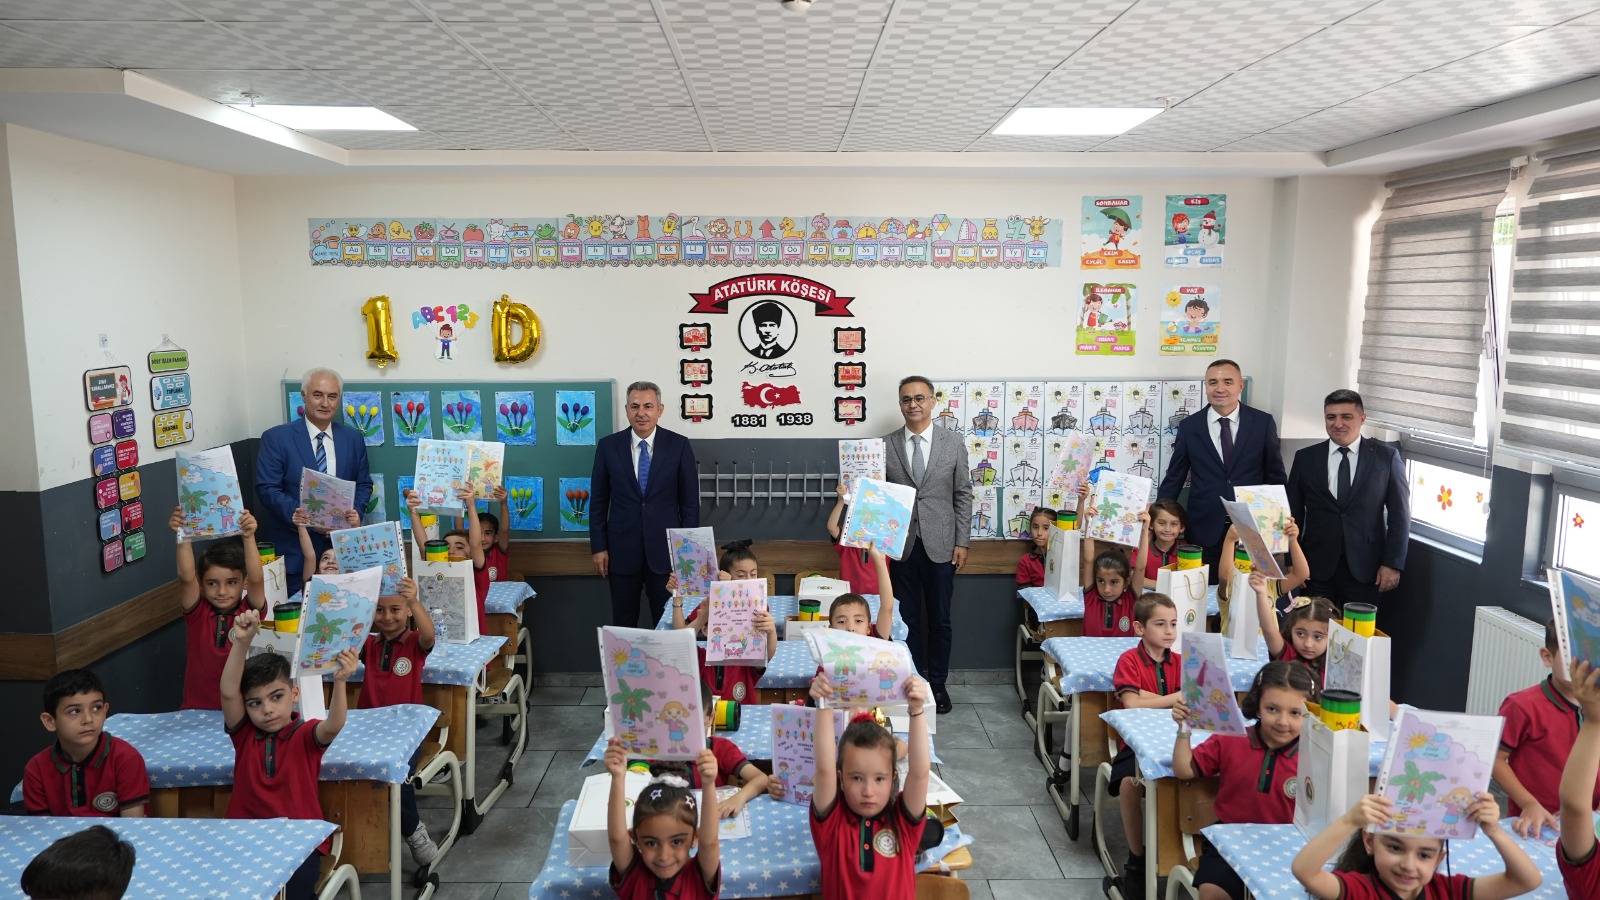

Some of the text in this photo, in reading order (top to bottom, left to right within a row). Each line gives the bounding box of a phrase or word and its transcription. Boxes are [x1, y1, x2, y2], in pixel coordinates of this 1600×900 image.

[348, 246, 359, 254] Aa
[395, 246, 406, 254] Cc
[419, 247, 430, 256] Çç
[445, 246, 456, 254] Dd
[469, 247, 478, 255] Ee
[516, 247, 527, 257] Gg
[567, 246, 577, 254] Hh
[641, 246, 647, 255] Jj
[689, 245, 697, 253] Ll
[739, 246, 750, 254] Nn
[761, 245, 774, 253] Oo
[813, 246, 824, 255] Pp
[910, 246, 919, 254] Tt
[936, 247, 947, 255] Uu
[984, 247, 995, 255] Vv
[1009, 247, 1018, 258] Yy
[1031, 247, 1041, 256] Zz
[714, 277, 832, 304] ATATÜRK KÖŞESİ
[360, 295, 399, 363] 1
[411, 303, 480, 329] ABC 123
[491, 299, 541, 364] D
[733, 413, 812, 427] 1881 1938
